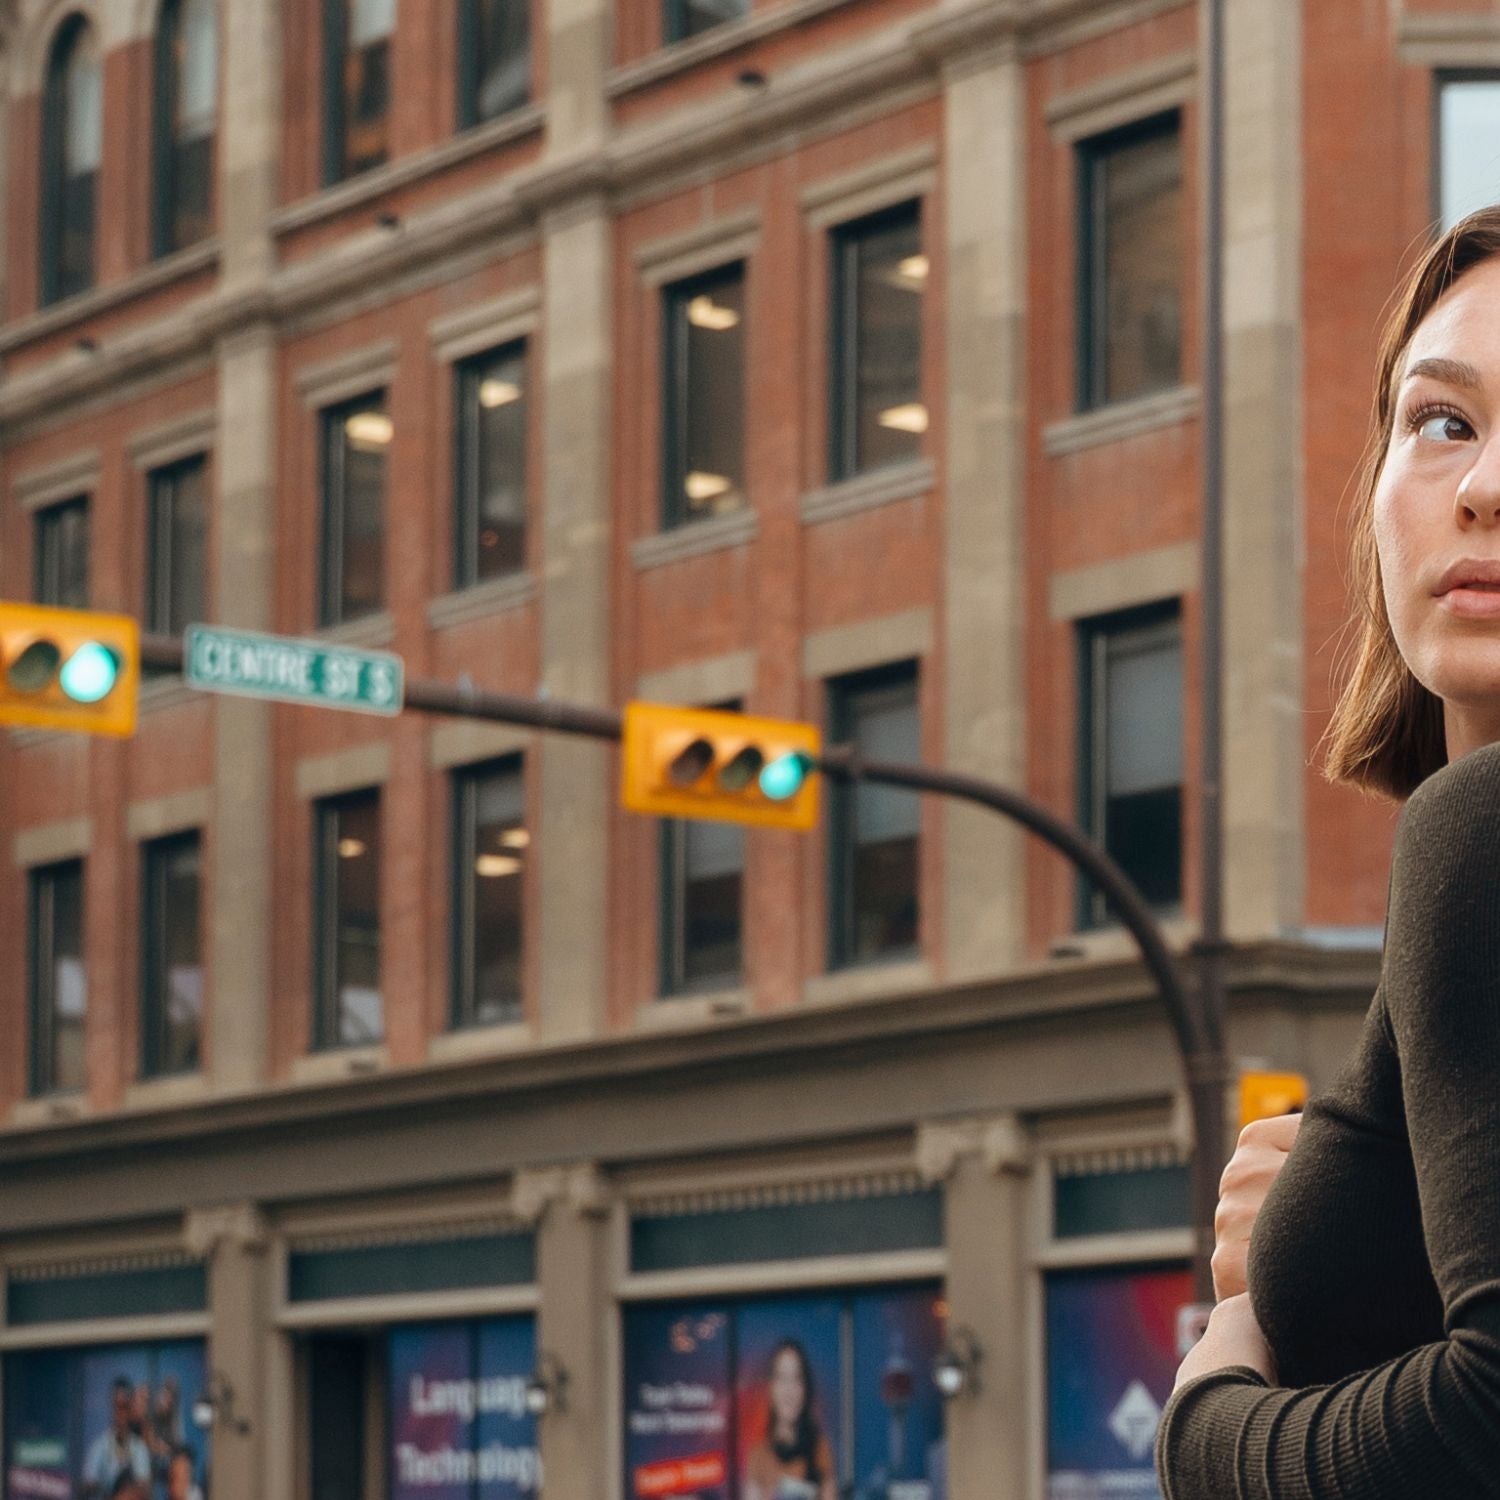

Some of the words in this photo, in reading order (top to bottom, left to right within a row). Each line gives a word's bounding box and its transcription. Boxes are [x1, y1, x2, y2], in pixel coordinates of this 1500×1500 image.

[204, 640, 312, 693] CENTRE
[326, 658, 364, 699] ST
[370, 664, 394, 704] S
[410, 1373, 528, 1424] Languag
